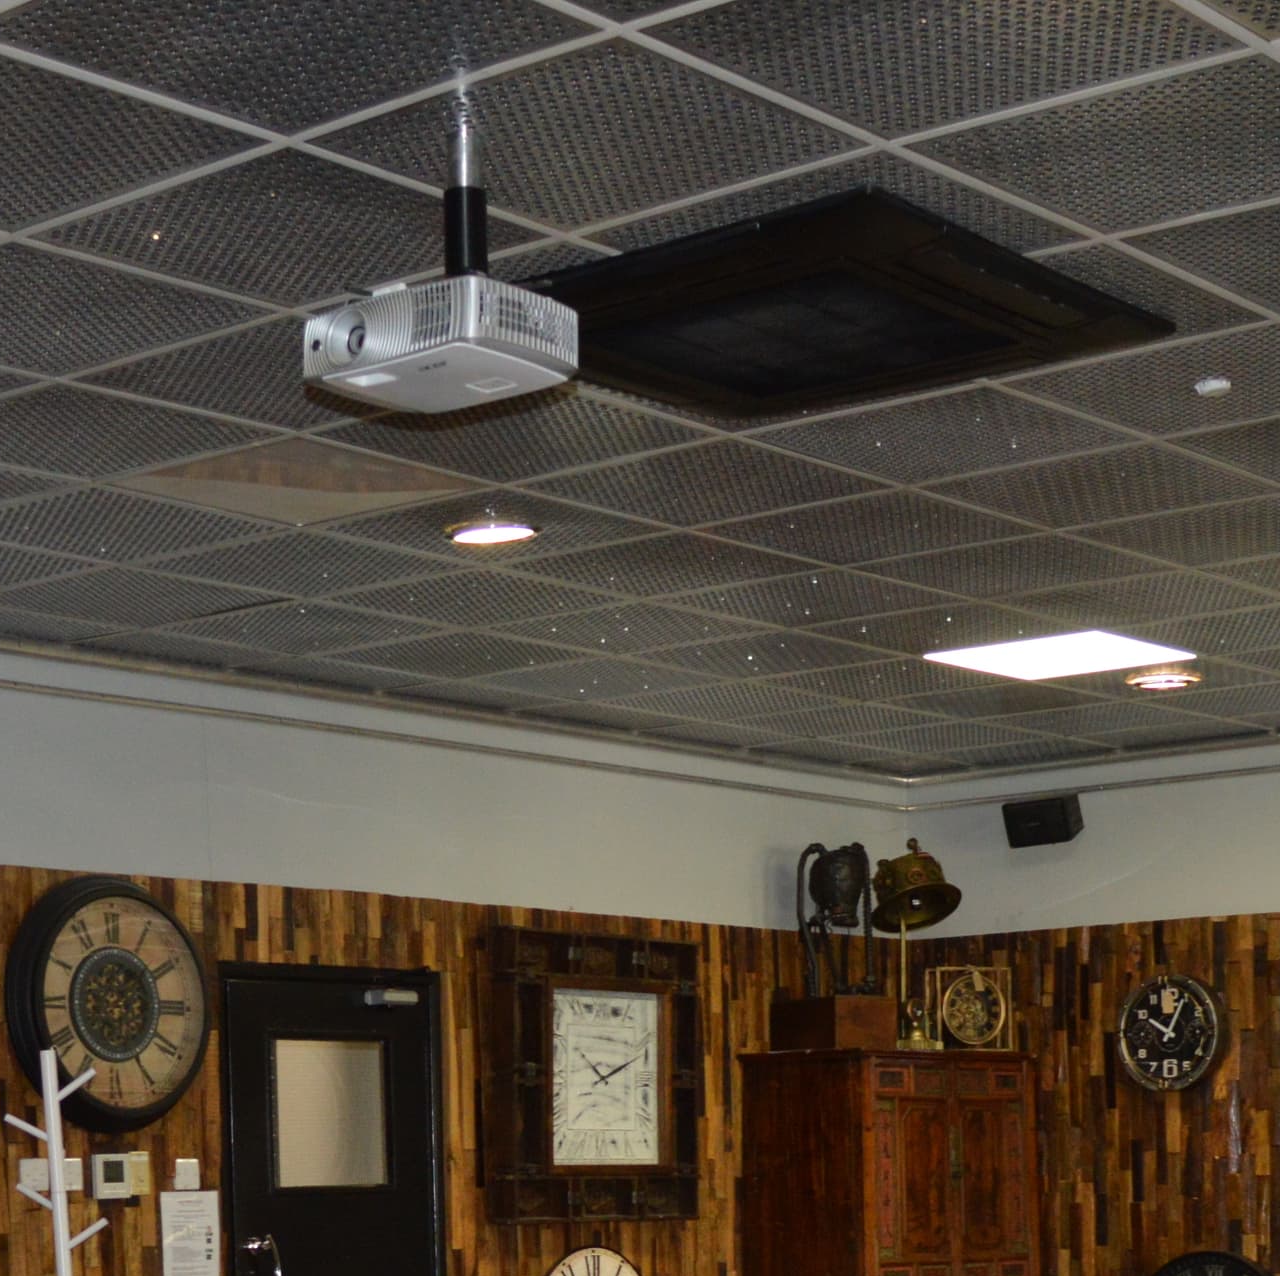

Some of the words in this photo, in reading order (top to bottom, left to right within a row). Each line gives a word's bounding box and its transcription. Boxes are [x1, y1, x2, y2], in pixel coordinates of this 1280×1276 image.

[104, 912, 119, 944] XII
[152, 959, 175, 979] II
[160, 1000, 185, 1015] III
[1137, 1009, 1148, 1019] 10
[1138, 1049, 1147, 1058] 8
[1150, 1062, 1158, 1072] 7
[1163, 1059, 1178, 1078] 6
[1182, 1061, 1191, 1071] 5
